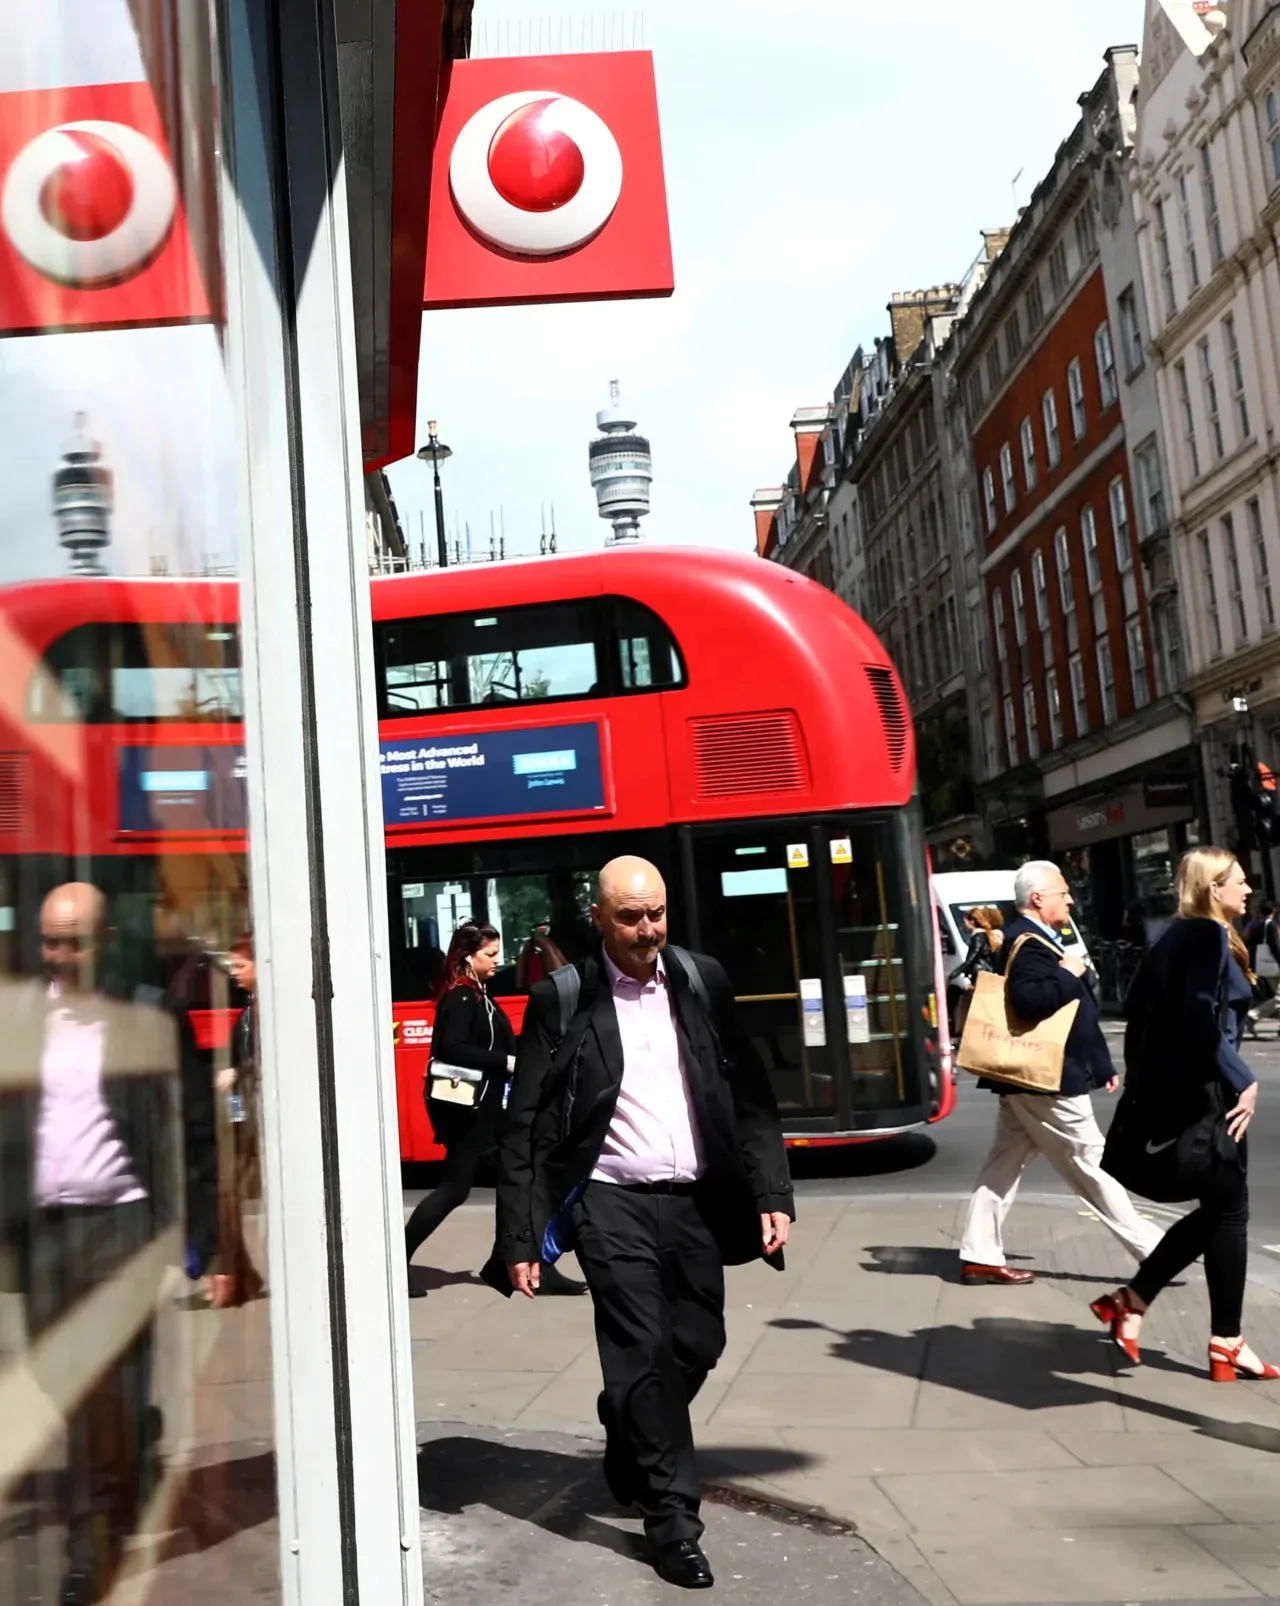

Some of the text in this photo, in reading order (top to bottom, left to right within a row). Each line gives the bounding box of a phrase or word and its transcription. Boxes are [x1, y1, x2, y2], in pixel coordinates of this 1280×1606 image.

[386, 750, 417, 761] Most
[417, 743, 478, 758] Advanced
[380, 754, 485, 774] tress in the World
